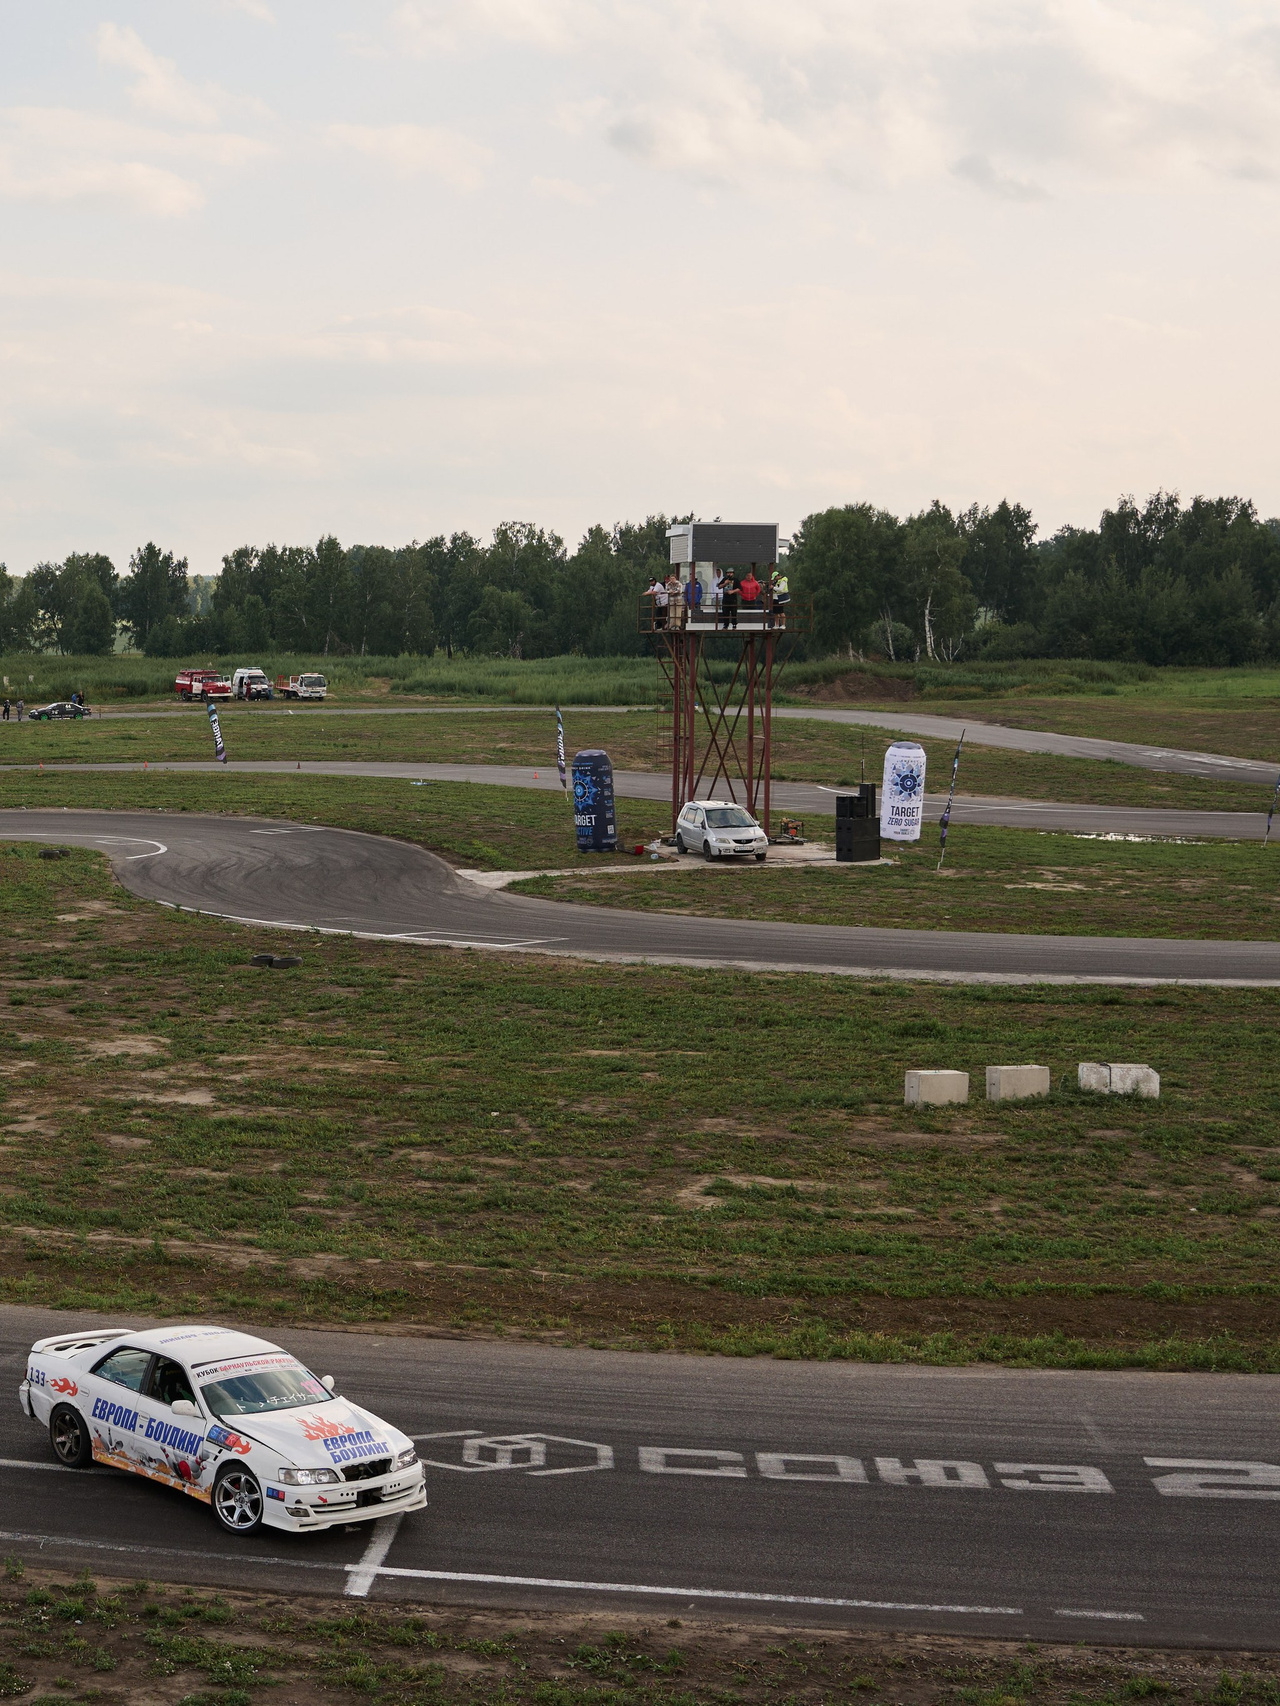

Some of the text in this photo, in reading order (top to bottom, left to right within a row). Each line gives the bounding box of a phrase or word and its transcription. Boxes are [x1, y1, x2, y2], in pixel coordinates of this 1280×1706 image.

[887, 816, 902, 826] ZERO
[891, 805, 920, 818] TARGET
[29, 1366, 46, 1387] 133
[195, 1367, 219, 1379] КУБОК
[219, 1358, 271, 1372] БАРНАУЛЬСКОЙ
[91, 1397, 140, 1433] ЕВРОПА
[144, 1417, 205, 1457] БОУЛИНГ
[210, 1426, 238, 1447] SKR
[323, 1430, 376, 1452] ЕВРОПА
[329, 1441, 390, 1465] БОУЛИНГ
[637, 1446, 1117, 1494] СОЮЗ
